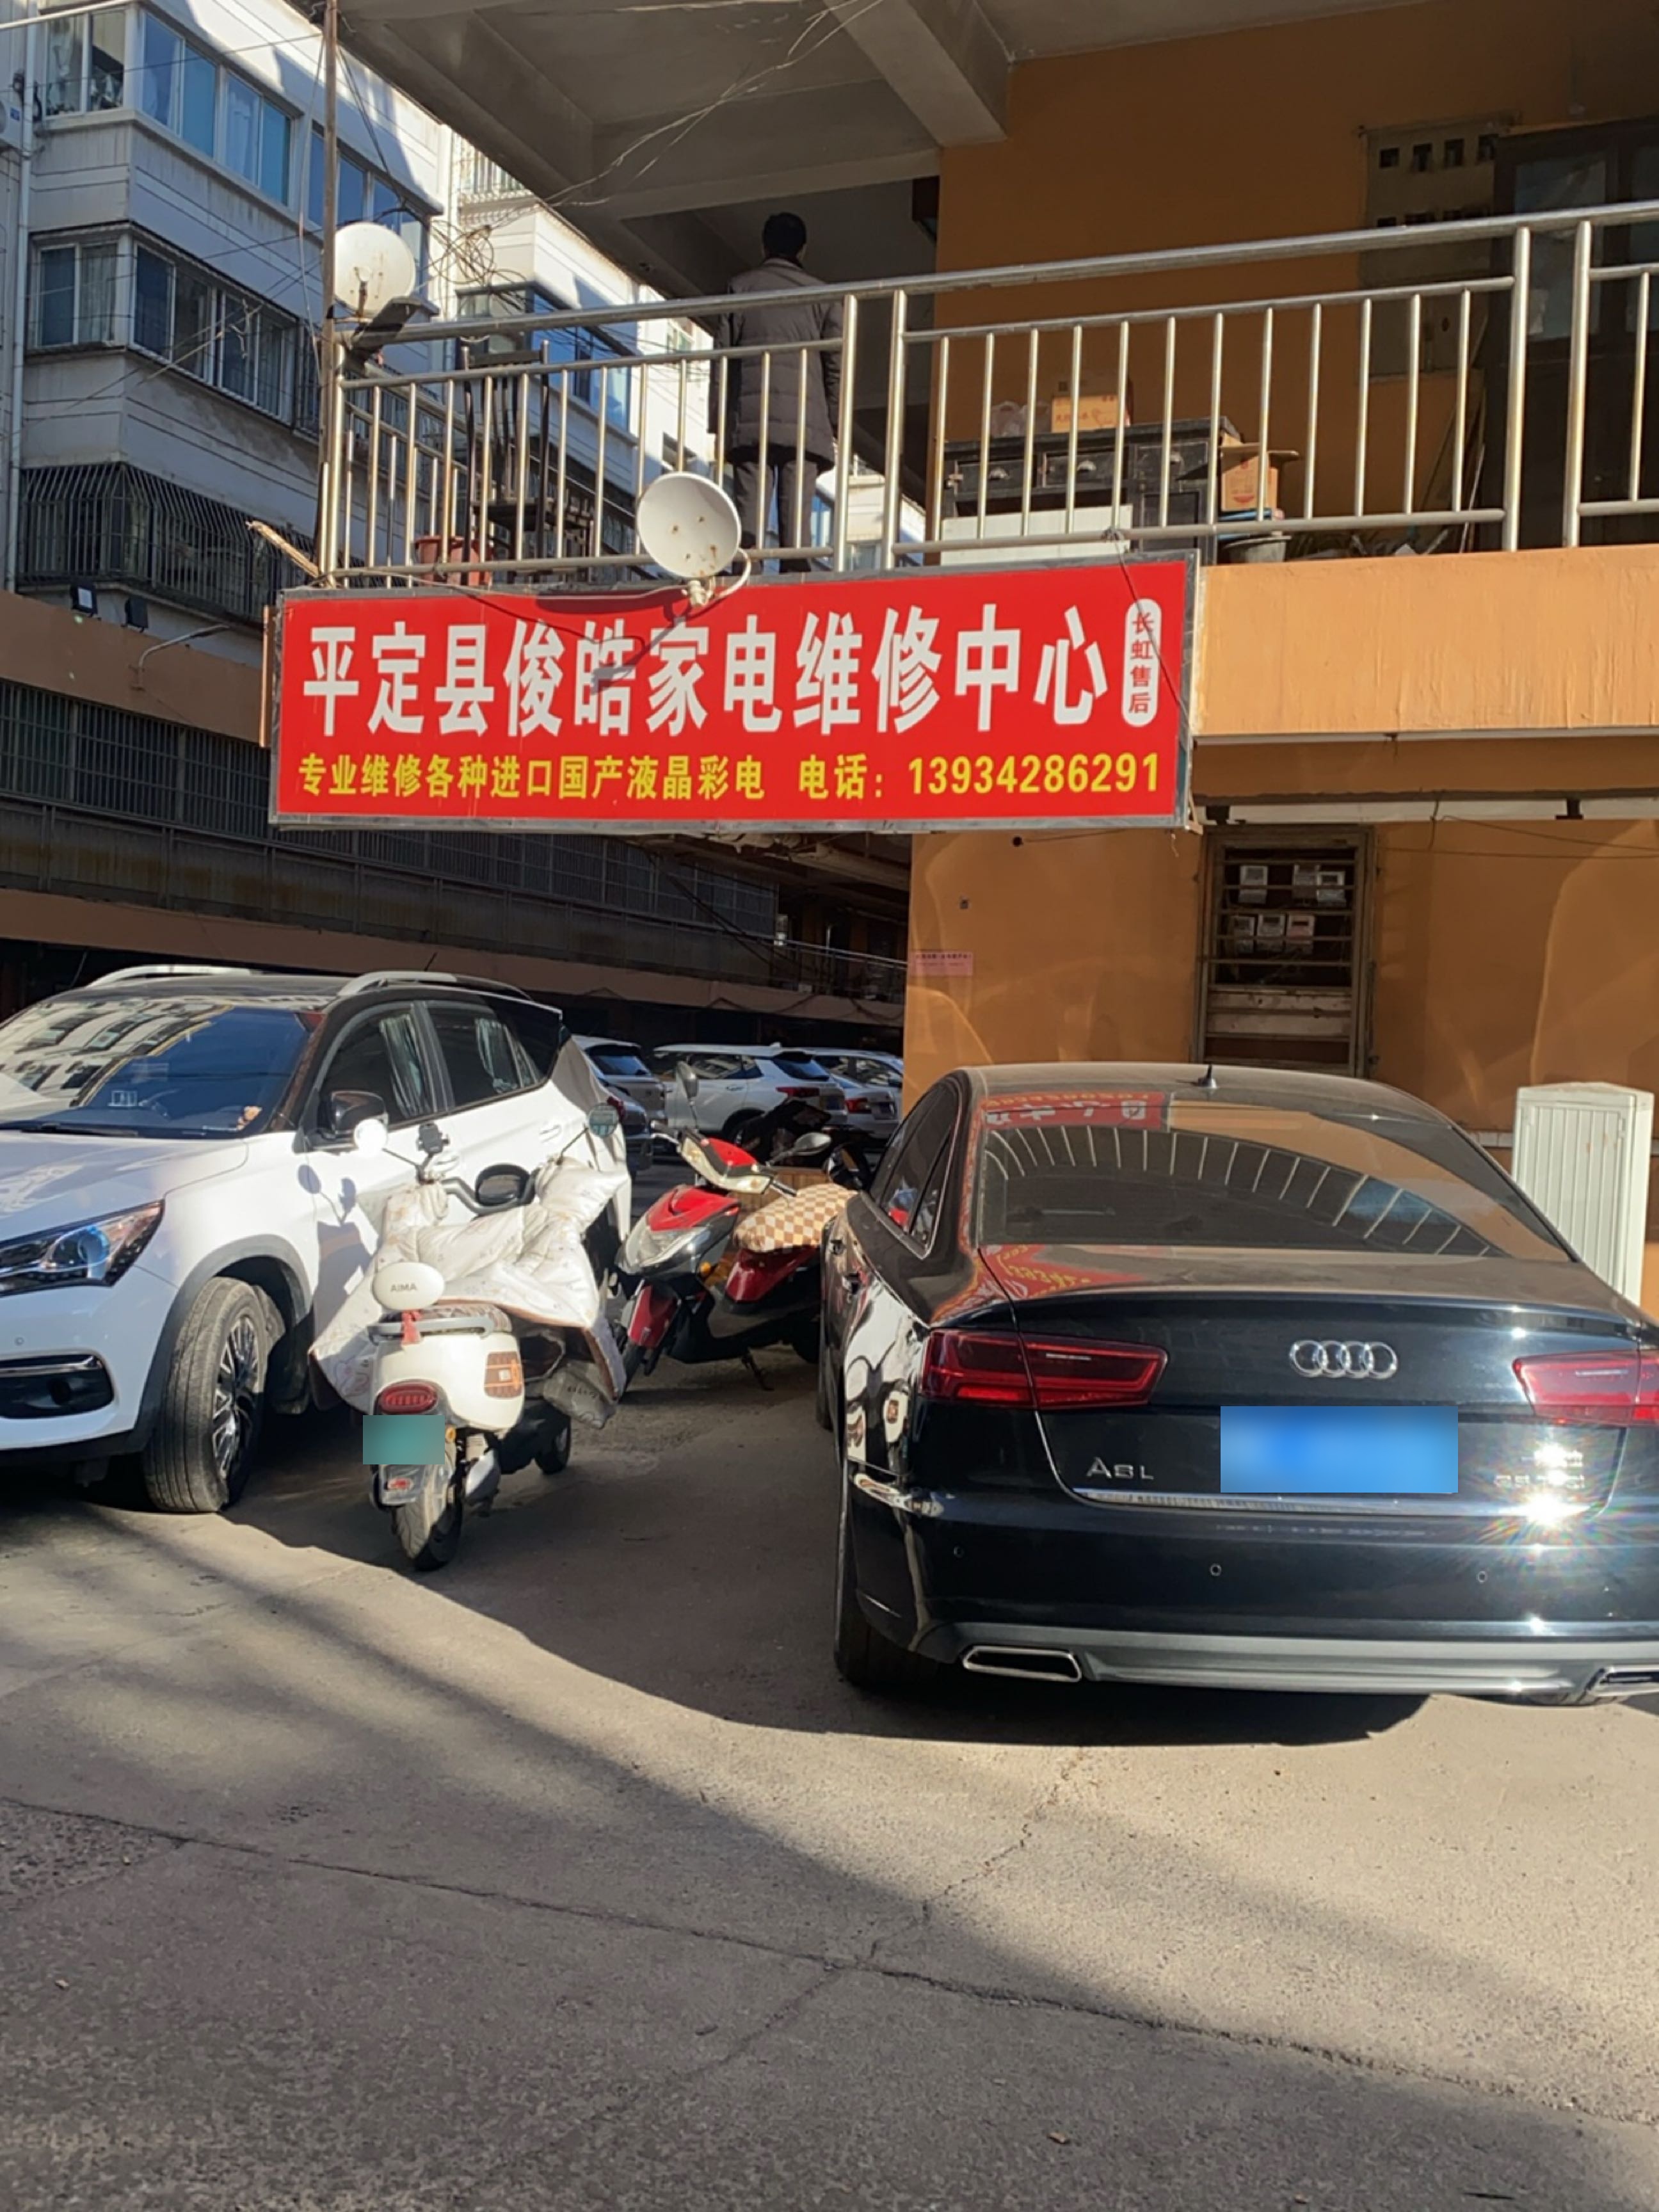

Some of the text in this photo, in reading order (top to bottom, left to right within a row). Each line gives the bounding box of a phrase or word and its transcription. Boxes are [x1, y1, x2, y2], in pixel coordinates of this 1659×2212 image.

[303, 603, 1109, 737] 平定县俊皓家电维修中心
[1129, 612, 1155, 714] 长虹售后
[298, 753, 765, 800] 专业维修各种进口国产液晶彩电
[908, 753, 1158, 794] 13934286291
